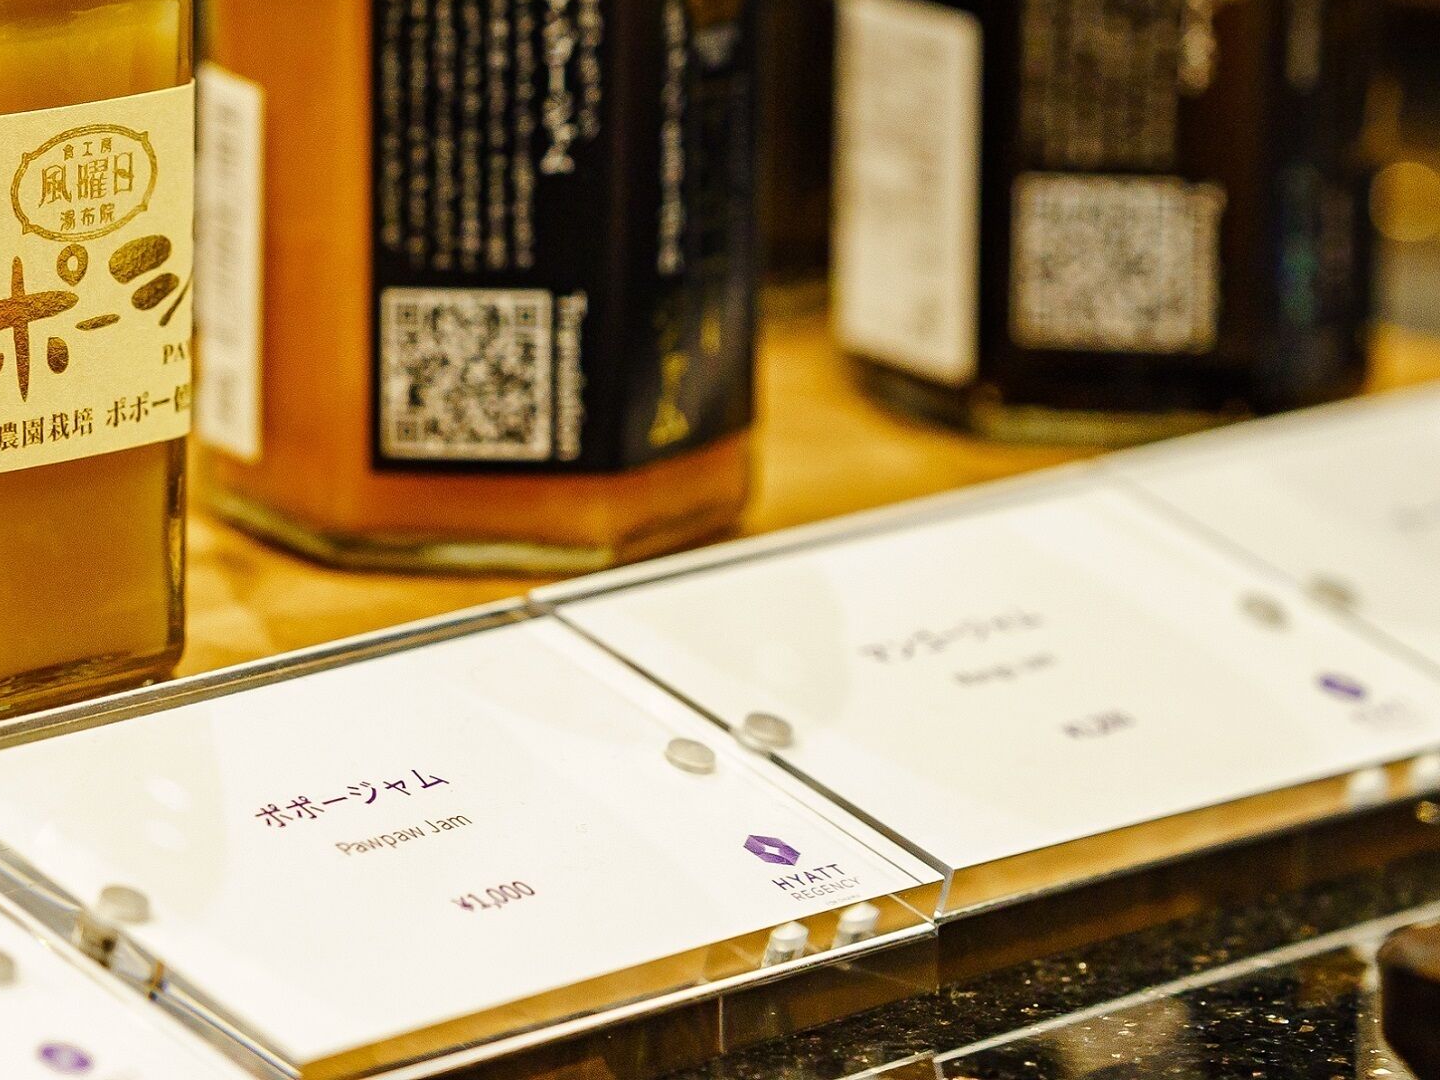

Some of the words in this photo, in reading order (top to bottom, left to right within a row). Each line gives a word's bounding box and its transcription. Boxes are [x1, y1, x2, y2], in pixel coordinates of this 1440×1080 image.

[38, 151, 135, 208] 風曜日
[255, 768, 450, 828] ポポージャム
[335, 824, 426, 856] Pawpaw
[430, 813, 473, 834] Jam
[770, 863, 846, 891] HYATT
[790, 876, 862, 903] REGENCY
